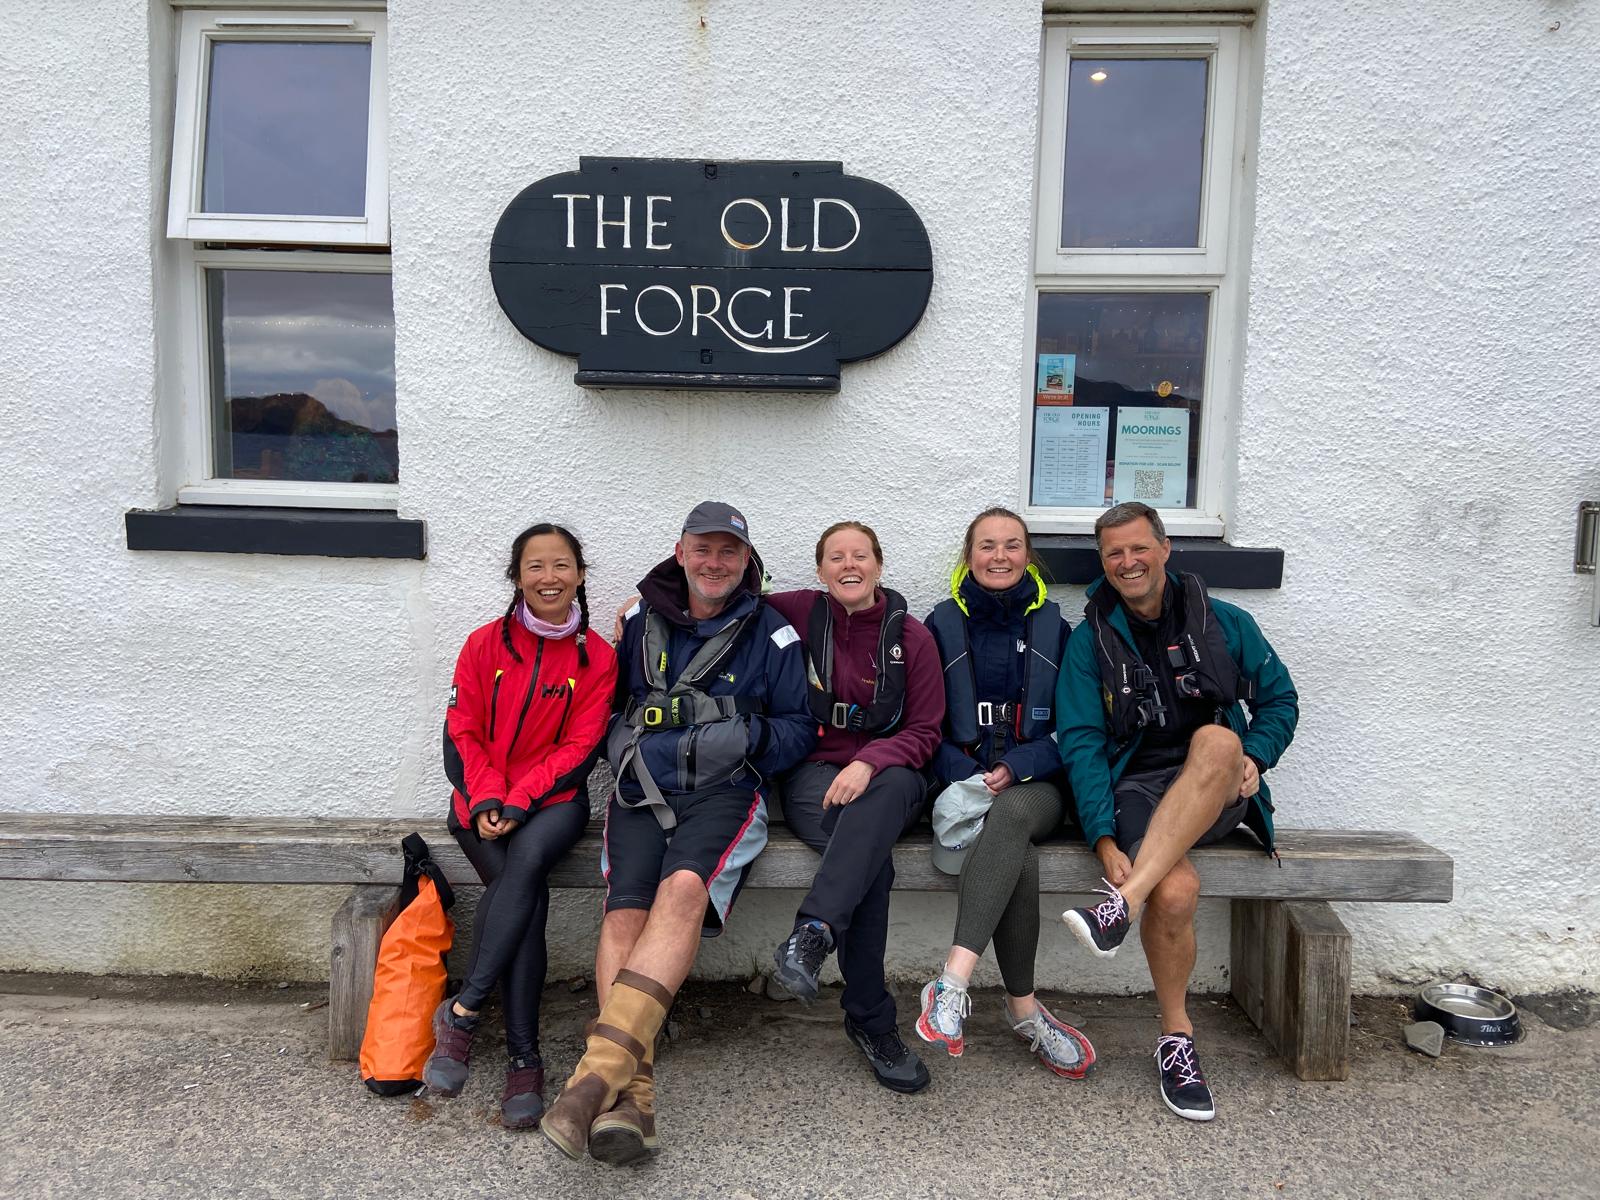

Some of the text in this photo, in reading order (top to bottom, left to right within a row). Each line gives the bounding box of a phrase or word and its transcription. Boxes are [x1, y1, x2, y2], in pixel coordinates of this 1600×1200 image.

[552, 194, 861, 253] THE OLD
[600, 284, 830, 353] FORGE
[1071, 412, 1101, 420] OPENING
[1121, 425, 1182, 436] MOORINGS
